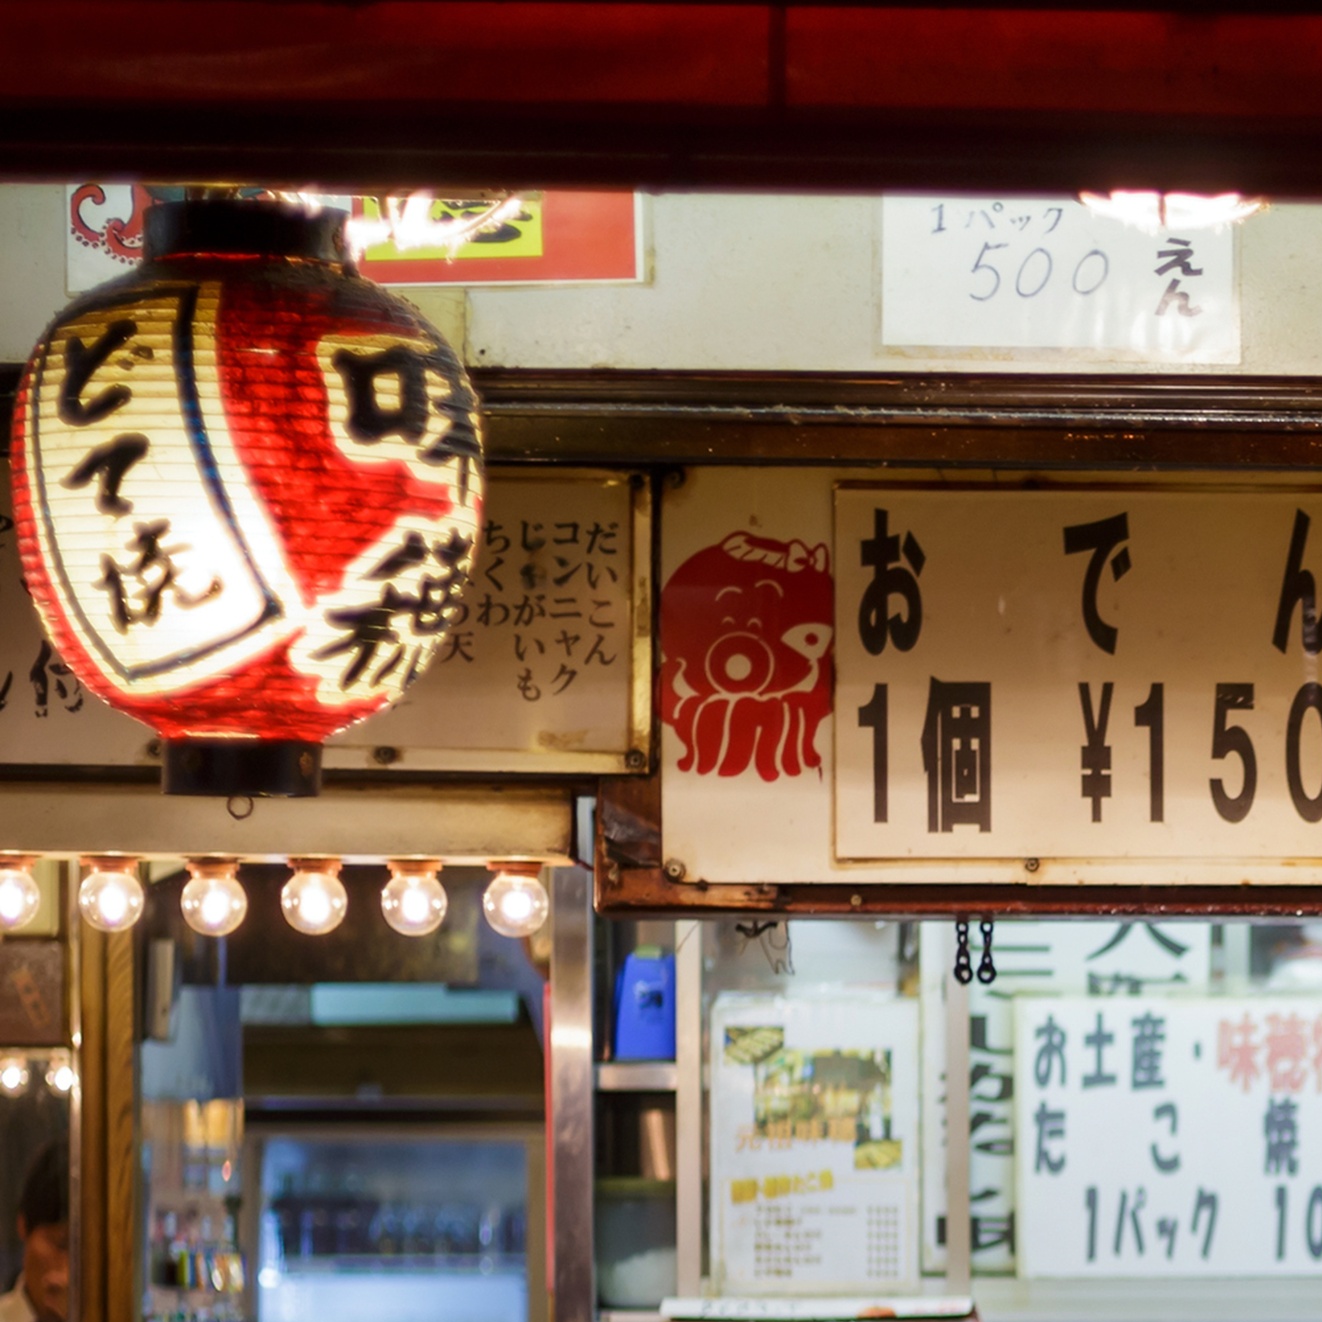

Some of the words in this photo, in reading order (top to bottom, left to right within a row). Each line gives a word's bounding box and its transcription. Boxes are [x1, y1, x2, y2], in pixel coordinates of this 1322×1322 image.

[930, 201, 1064, 234] 1パック
[968, 242, 1110, 302] 500
[1153, 237, 1204, 317] えん
[59, 319, 224, 635] どて焼
[476, 519, 511, 627] ちくわ
[512, 520, 547, 702] じがいも
[583, 522, 619, 667] だいこん
[857, 676, 993, 834] 1個
[1085, 1186, 1219, 1263] 1パック
